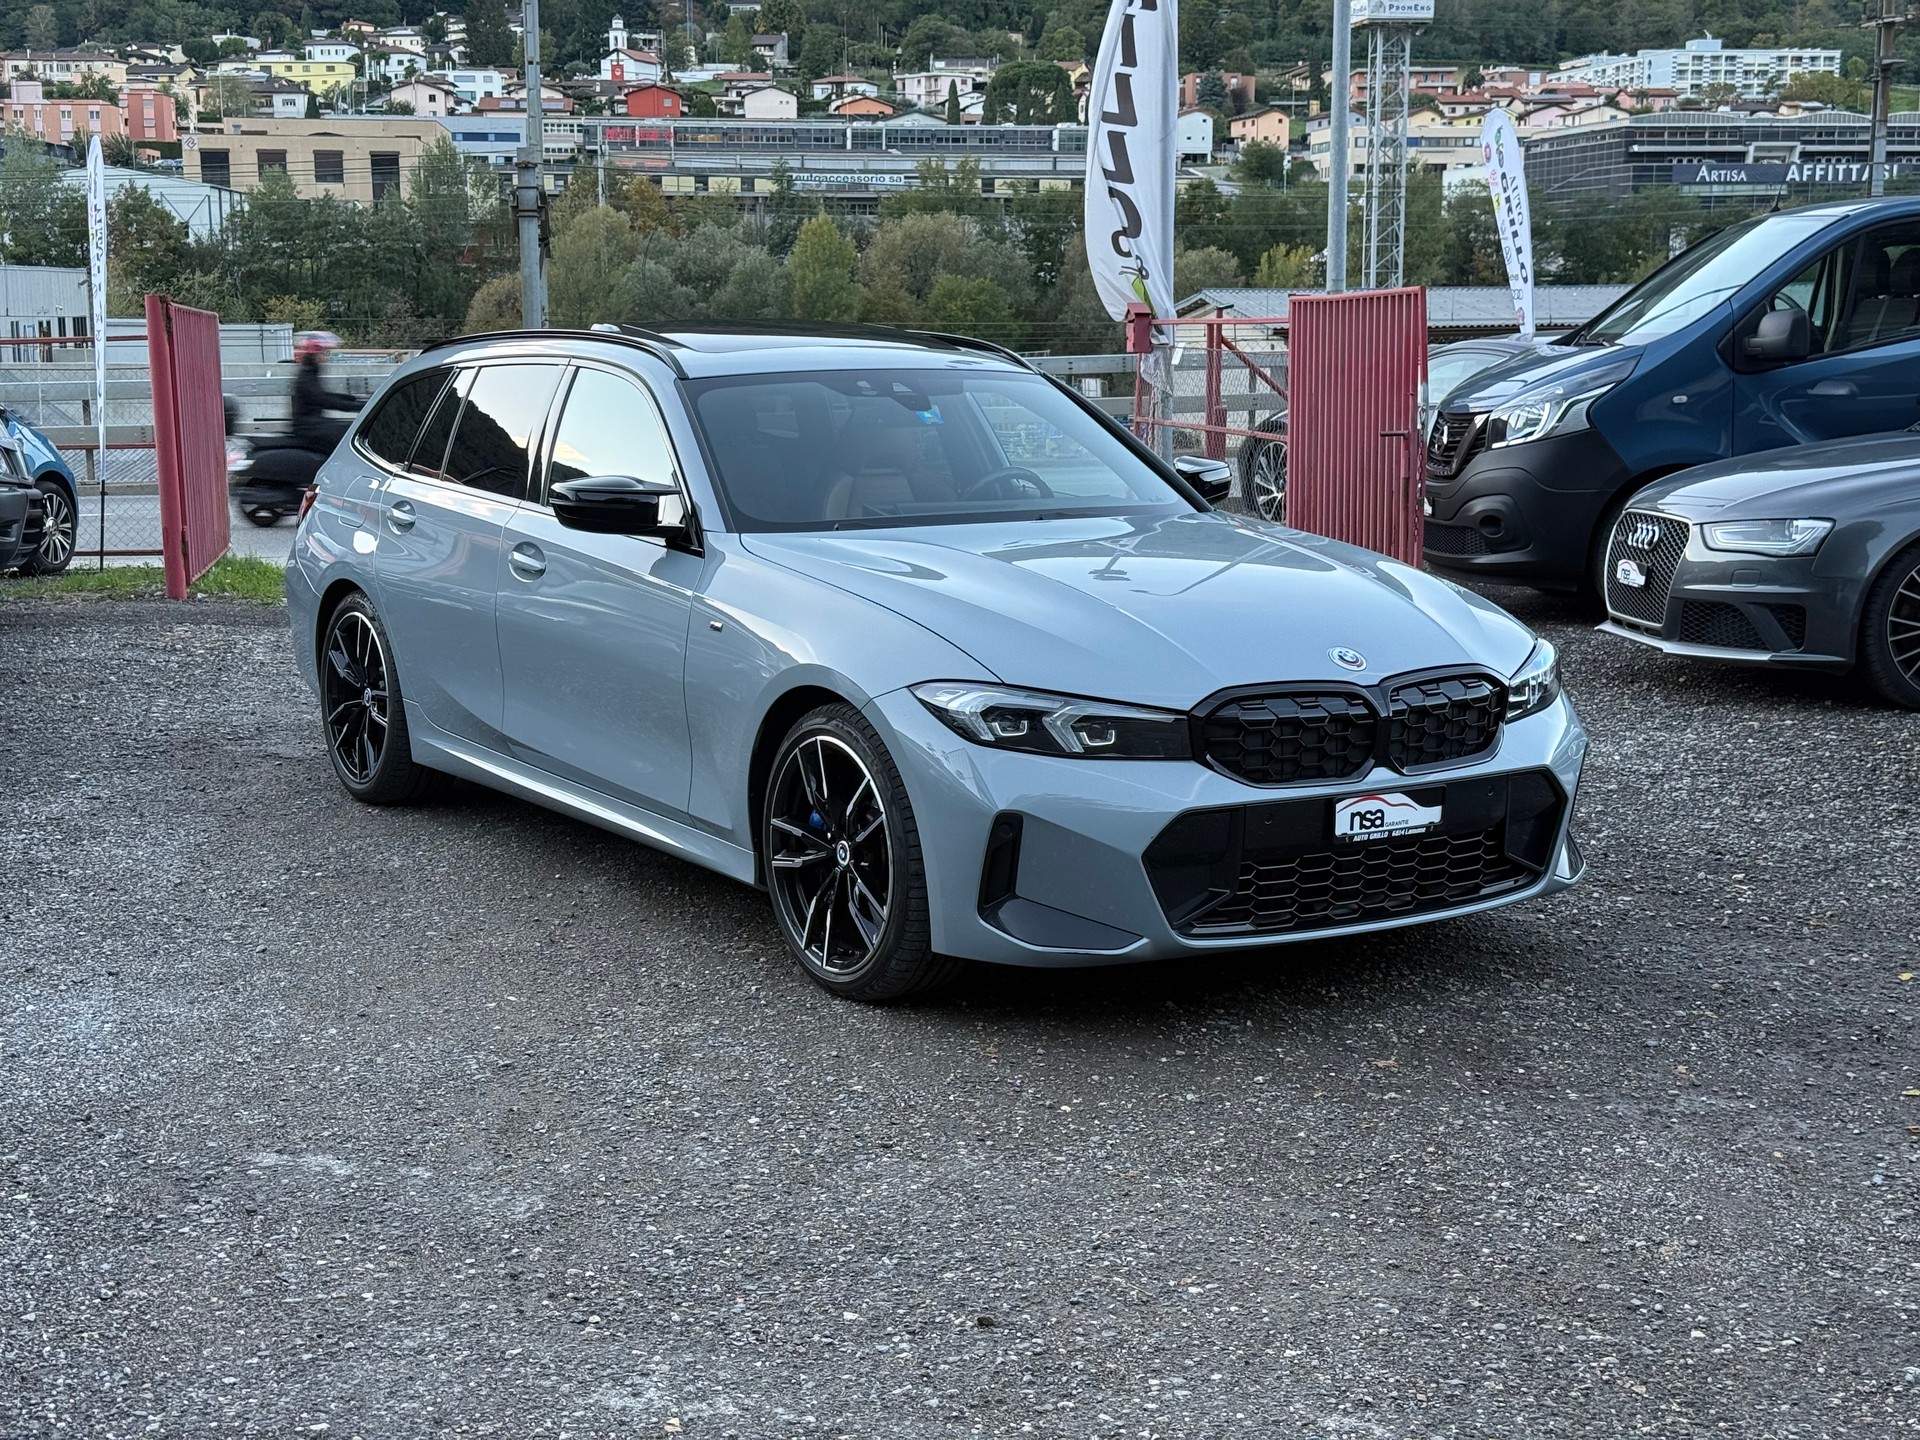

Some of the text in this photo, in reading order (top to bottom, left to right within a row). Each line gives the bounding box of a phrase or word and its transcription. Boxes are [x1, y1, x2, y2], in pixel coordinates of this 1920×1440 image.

[1508, 175, 1524, 226] AUTO
[1500, 172, 1529, 284] GRILLO
[1350, 808, 1385, 831] nsa
[1353, 834, 1369, 842] AUTO
[1369, 831, 1389, 840] GRILLO
